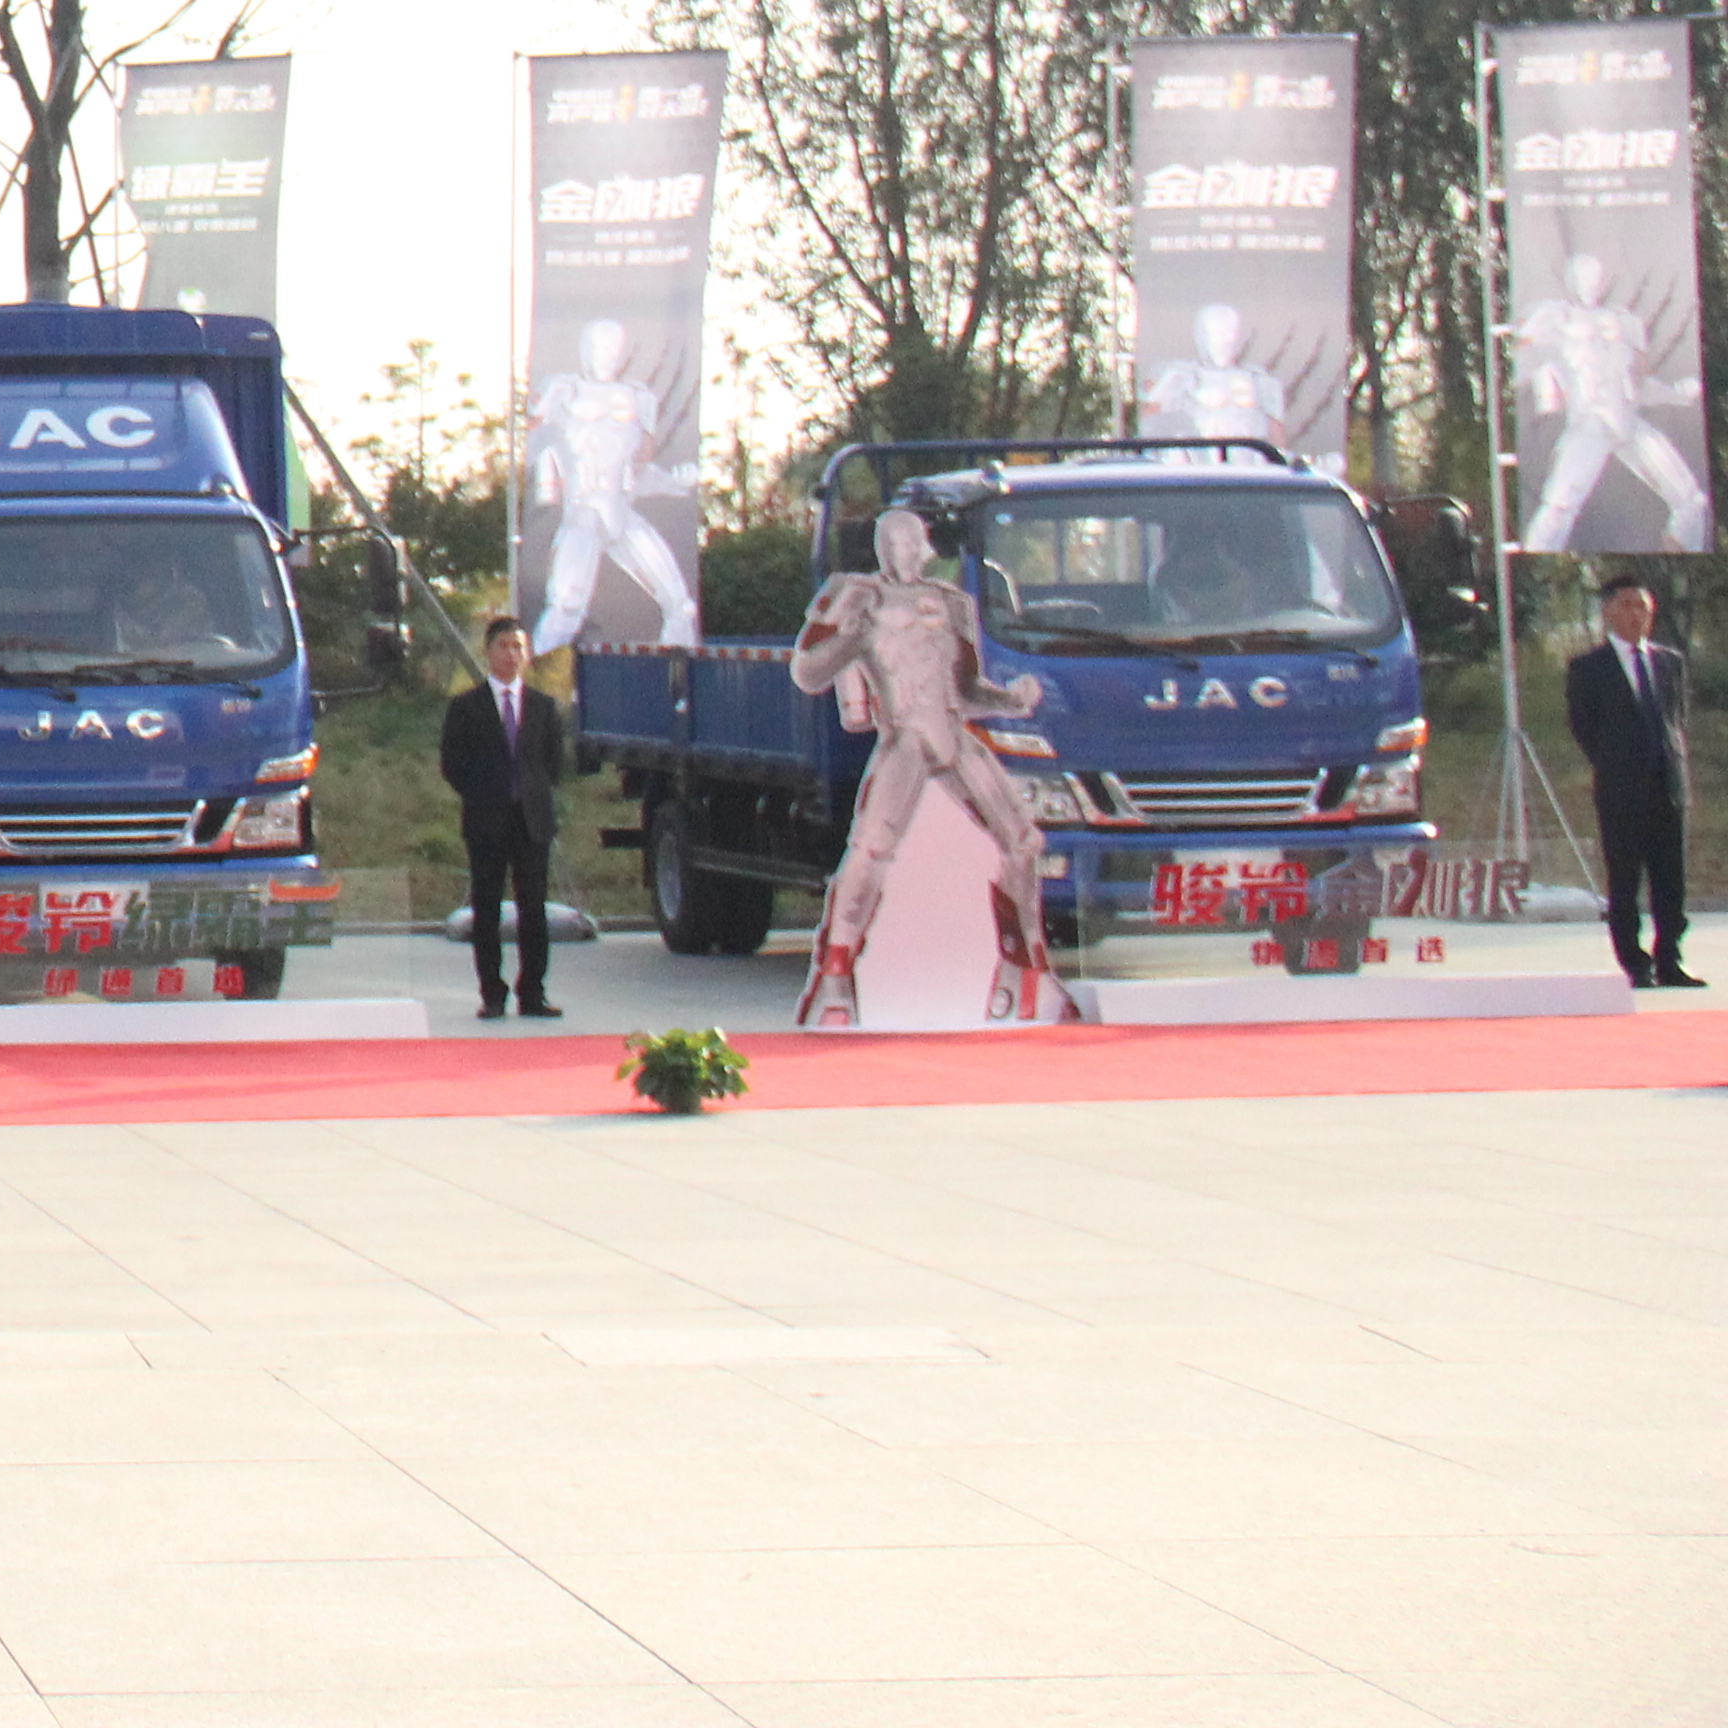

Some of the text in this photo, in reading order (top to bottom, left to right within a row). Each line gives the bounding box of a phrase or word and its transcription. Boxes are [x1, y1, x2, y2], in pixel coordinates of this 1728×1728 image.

[1513, 129, 1680, 172] 金刚狼
[129, 157, 272, 202] 绿霸王
[538, 172, 707, 223] 金刚狼
[1142, 161, 1340, 209] 金刚狼
[1143, 675, 1289, 710] JAC
[17, 708, 167, 741] JAC
